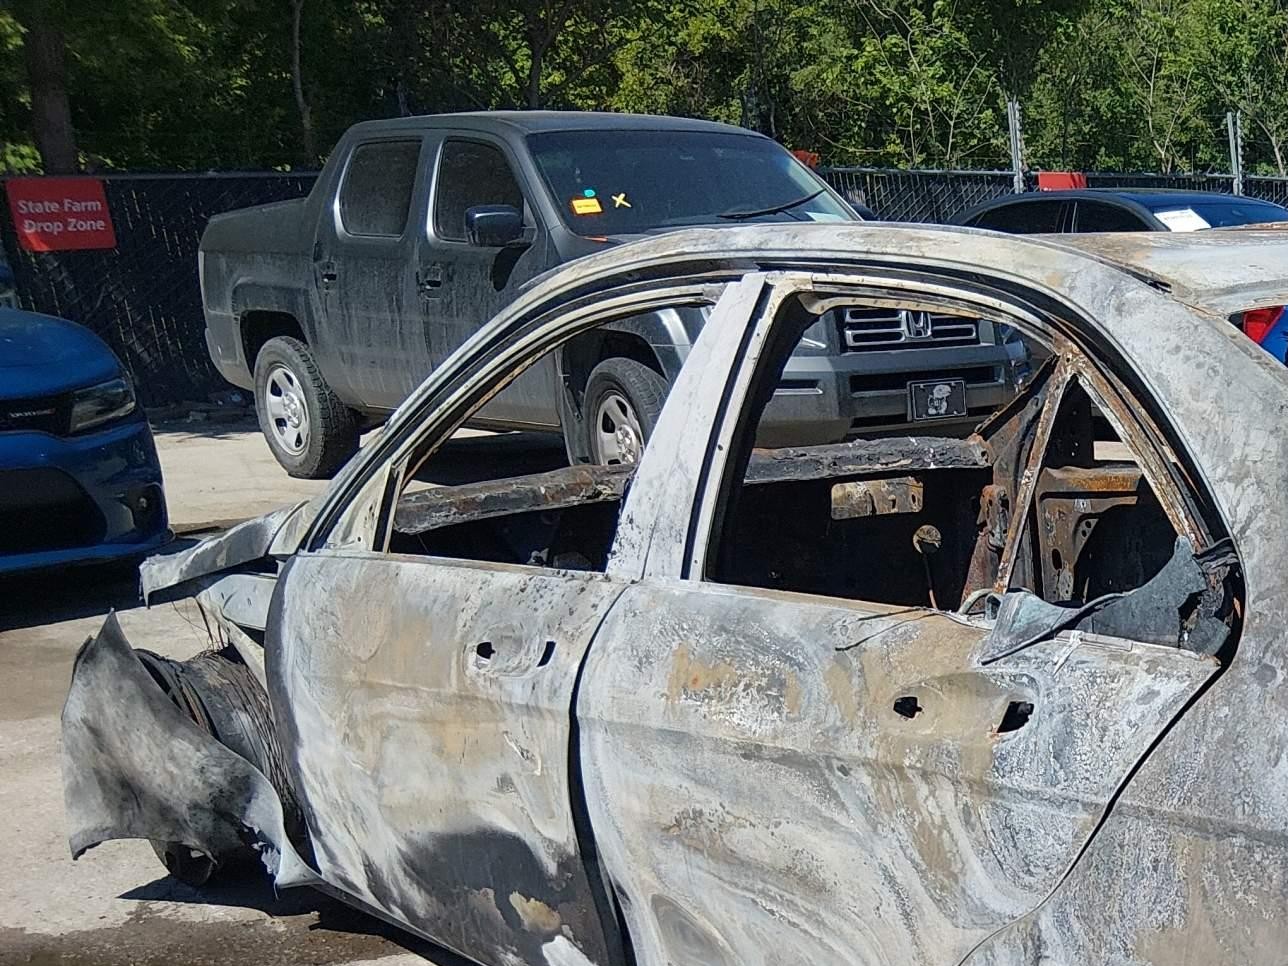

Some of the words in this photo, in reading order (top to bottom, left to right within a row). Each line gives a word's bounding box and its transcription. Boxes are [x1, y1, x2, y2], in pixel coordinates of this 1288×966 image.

[17, 200, 60, 214] State
[63, 199, 102, 212] Farm
[24, 220, 63, 236] Drop
[67, 218, 105, 231] Zone
